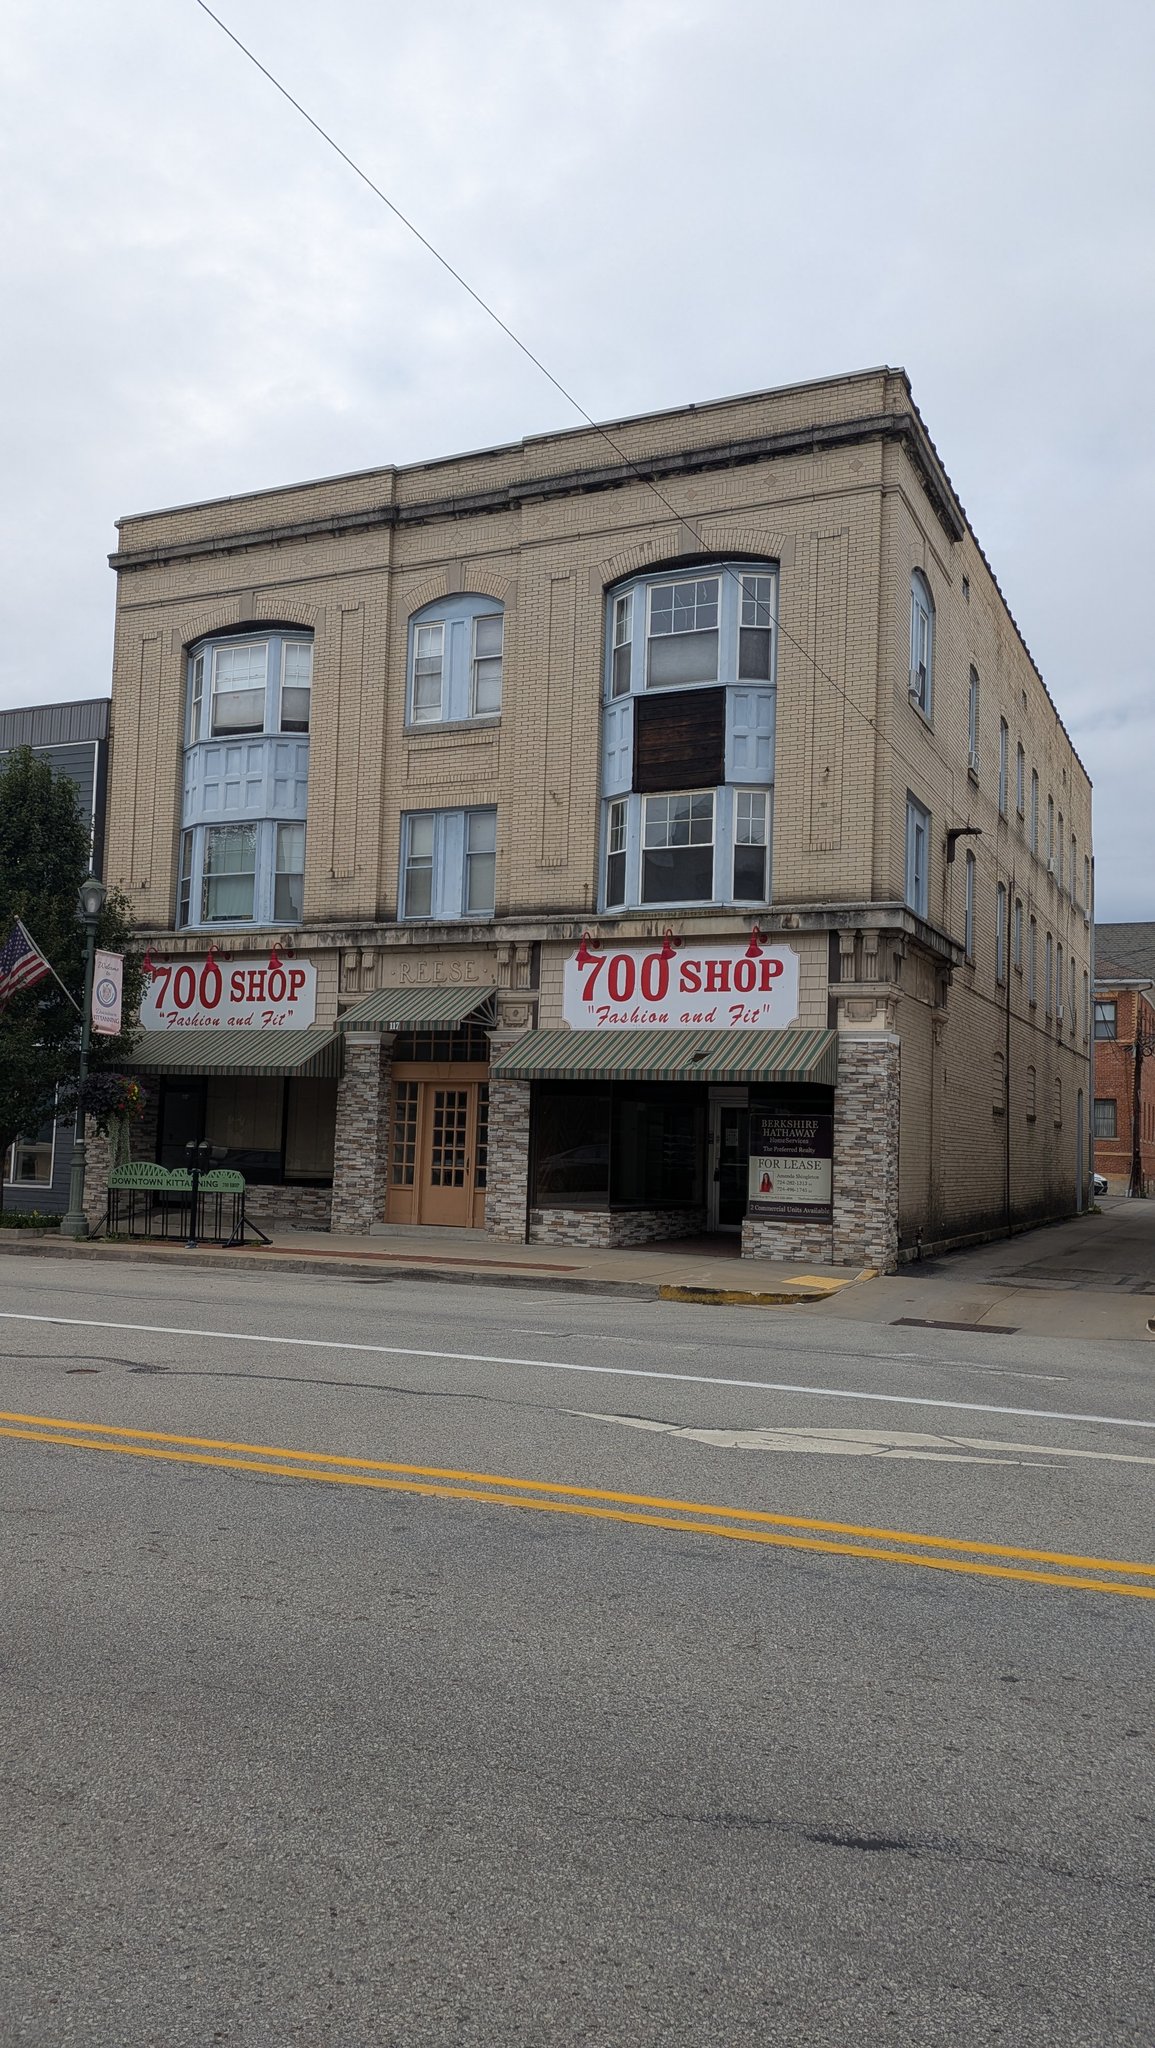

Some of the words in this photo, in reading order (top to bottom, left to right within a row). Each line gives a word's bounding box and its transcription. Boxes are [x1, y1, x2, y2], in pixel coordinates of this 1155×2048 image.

[399, 960, 480, 984] REESE
[577, 953, 670, 1002] 700
[679, 959, 784, 993] SHOP
[151, 966, 223, 1009] 700
[230, 968, 306, 1002] SHOP
[227, 1011, 253, 1026] and
[680, 1007, 717, 1024] and
[389, 1022, 400, 1030] 117
[761, 1119, 819, 1129] BERKSHIRE
[763, 1128, 817, 1138] HATHAWAY
[758, 1158, 781, 1169] FOR
[784, 1159, 822, 1170] LEASE
[111, 1177, 164, 1187] DOWNTOWN
[166, 1179, 219, 1188] KITTANING
